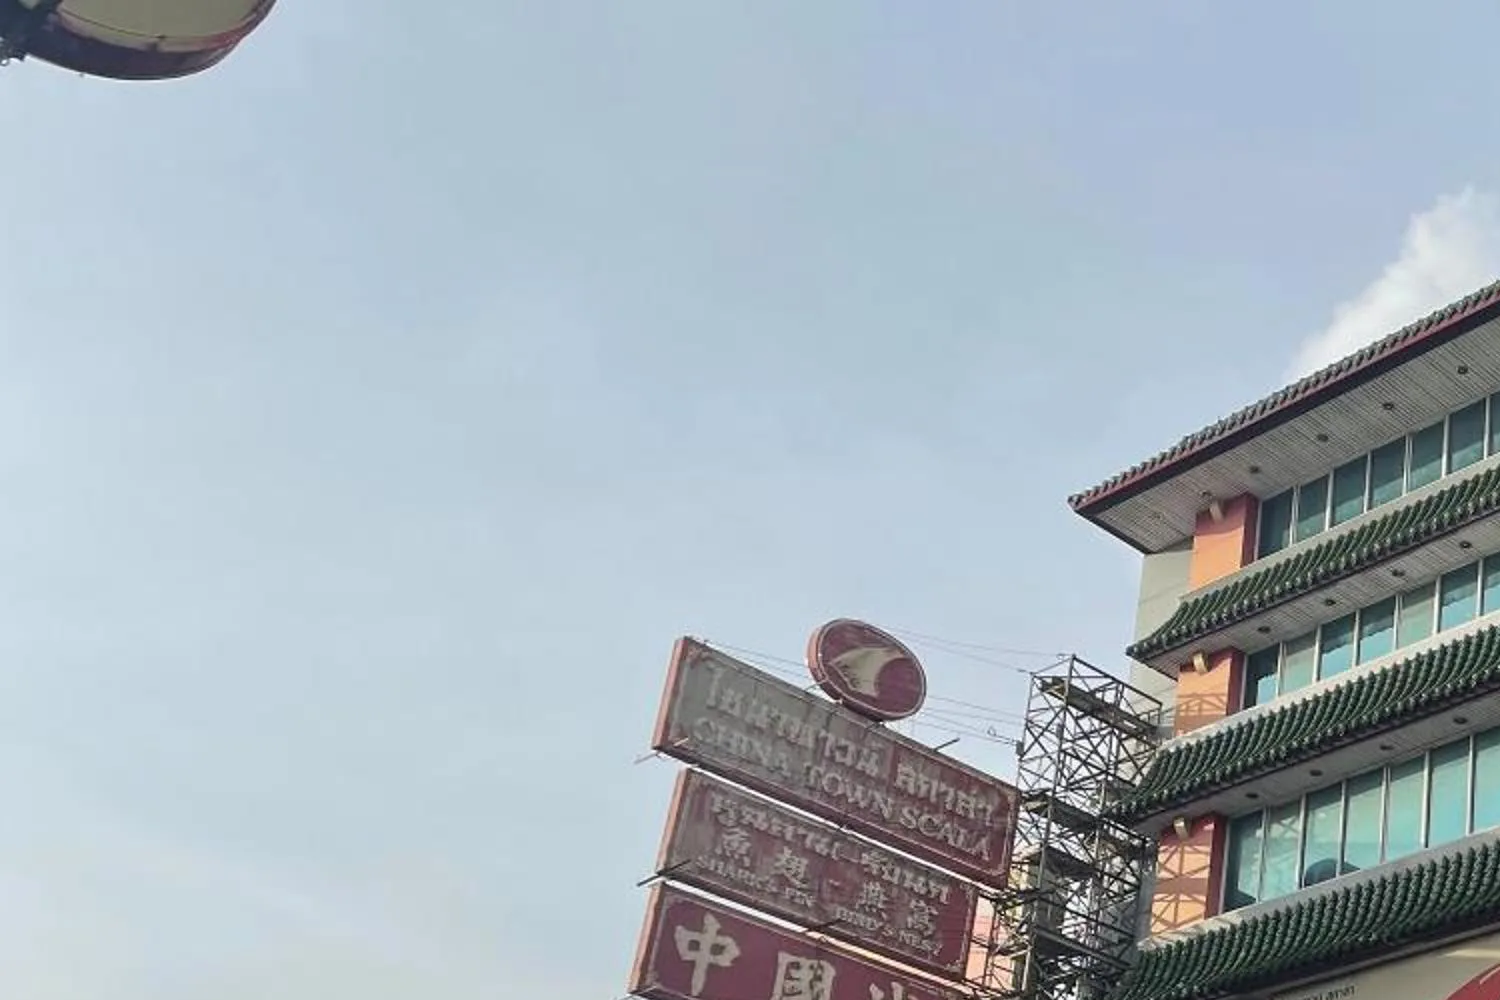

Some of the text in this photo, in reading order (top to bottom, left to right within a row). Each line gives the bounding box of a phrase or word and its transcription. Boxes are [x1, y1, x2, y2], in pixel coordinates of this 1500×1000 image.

[694, 717, 790, 774] CHINA
[802, 762, 893, 818] TOWN
[900, 805, 991, 860] SCALA
